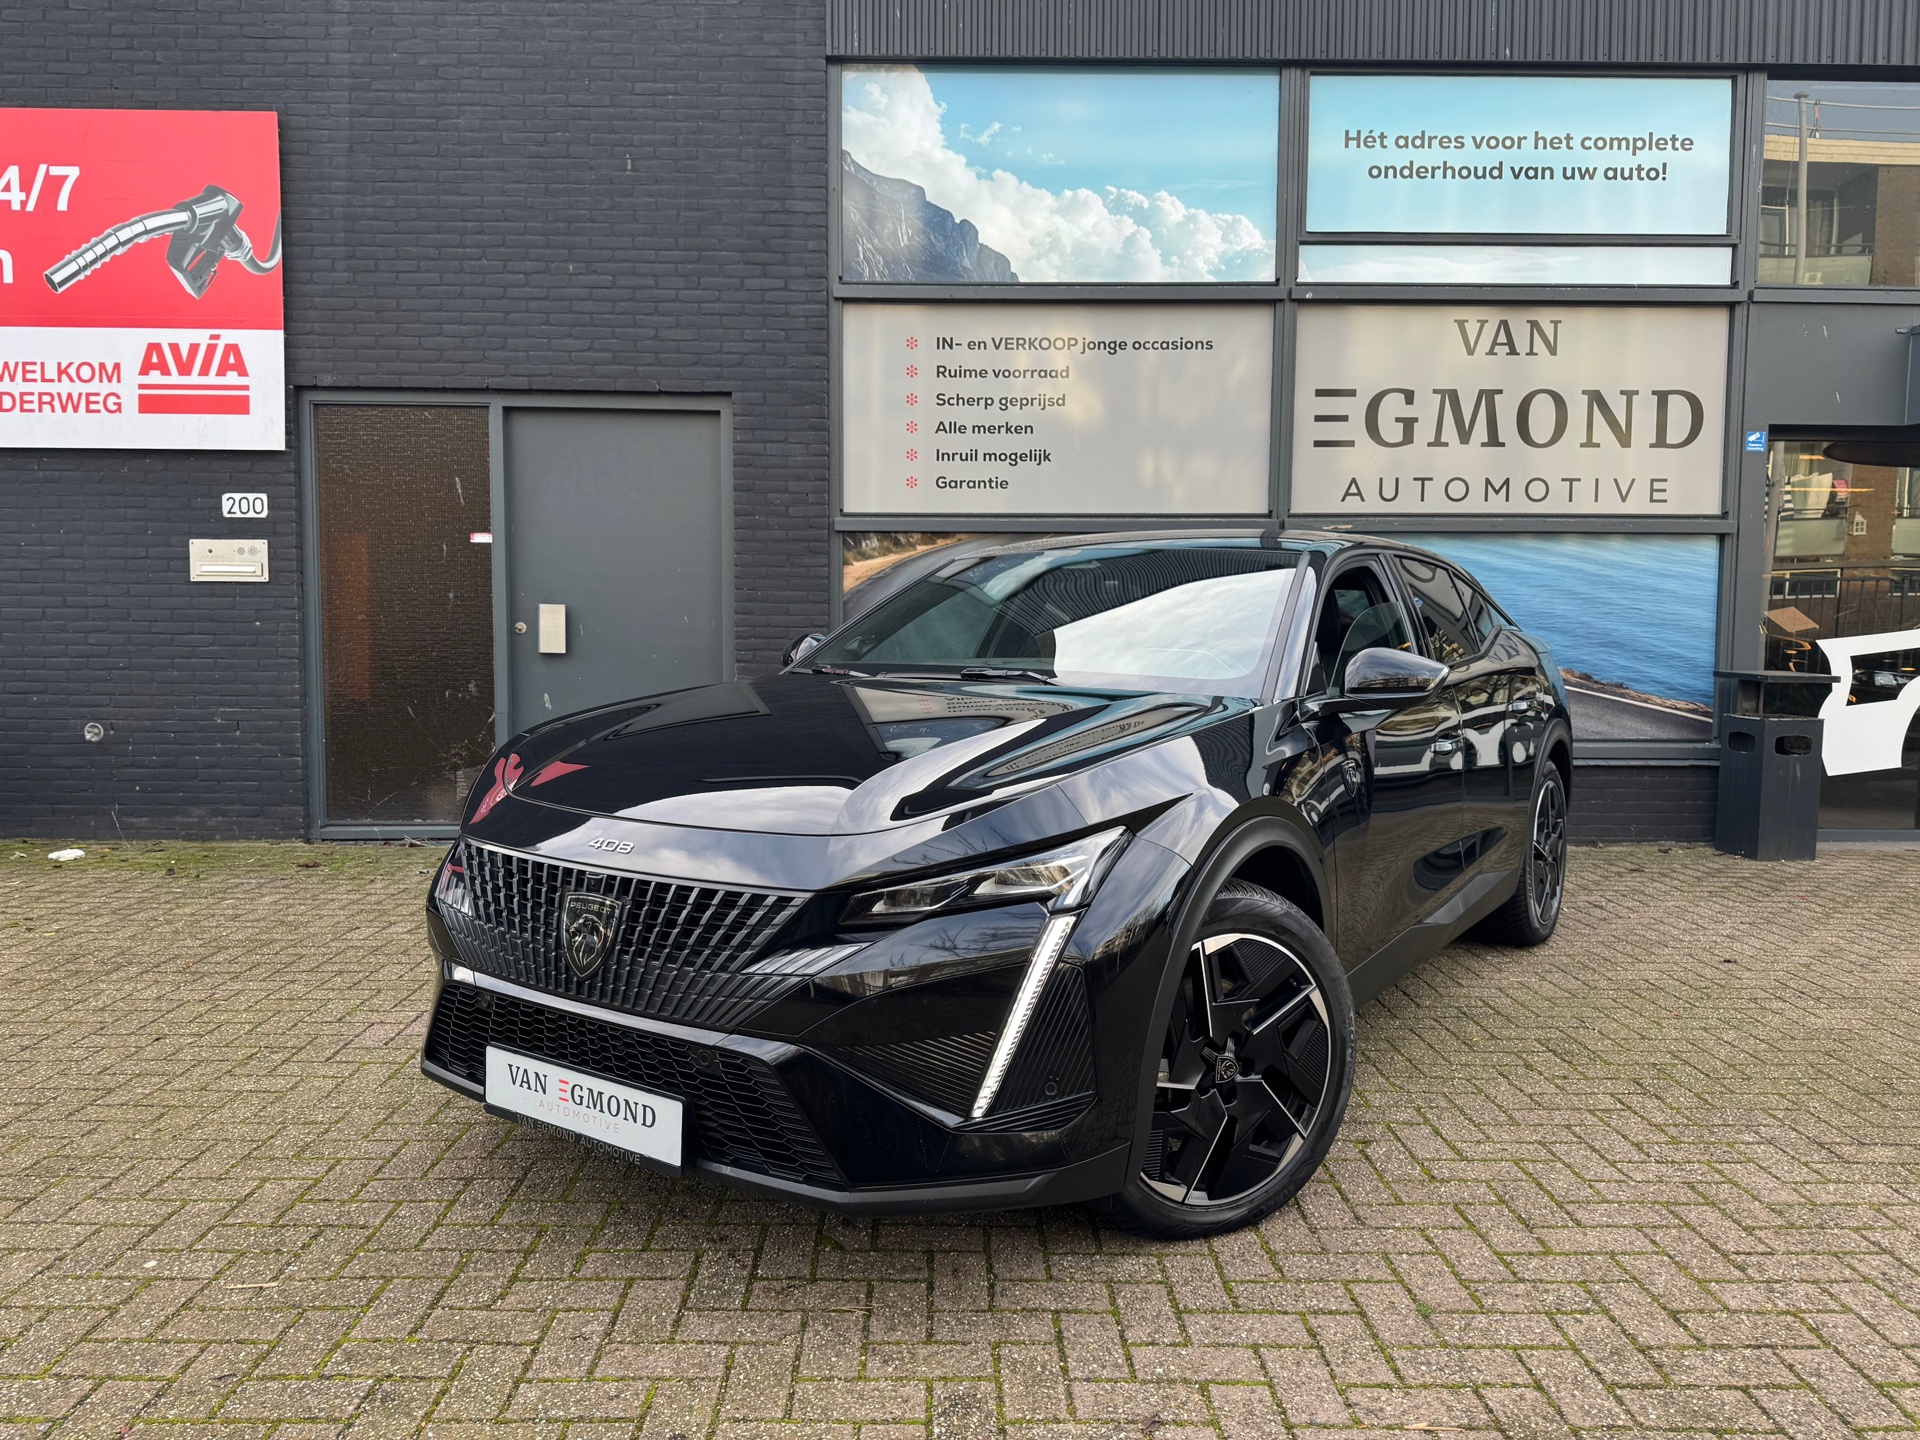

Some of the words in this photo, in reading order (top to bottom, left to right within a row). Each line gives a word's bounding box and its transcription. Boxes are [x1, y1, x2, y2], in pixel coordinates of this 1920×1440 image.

[1344, 129, 1388, 149] Hét
[1394, 130, 1466, 150] adres
[1470, 135, 1528, 150] voor
[1533, 131, 1574, 151] het
[1580, 131, 1694, 157] complete
[1367, 160, 1504, 180] onderhoud
[1509, 166, 1555, 181] van
[1562, 166, 1598, 181] uw
[1603, 161, 1668, 182] auto!
[936, 336, 963, 351] IN-
[967, 340, 987, 351] en
[990, 336, 1079, 351] VERKOOP
[1080, 337, 1128, 356] jonge
[1131, 336, 1214, 352] occasions
[1453, 318, 1563, 357] VAN
[0, 361, 122, 384] WELKOM
[936, 364, 989, 379] Ruime
[991, 364, 1070, 380] voorraad
[935, 392, 995, 411] Scherp
[998, 393, 1066, 411] geprijsd
[934, 420, 968, 435] Alle
[971, 420, 1034, 435] merken
[1312, 387, 1705, 450] EGMOND
[936, 448, 978, 462] Inruil
[982, 448, 1052, 467] mogelijk
[935, 475, 1009, 490] Garantie
[1340, 476, 1669, 504] AUTOMOTIVE
[226, 496, 265, 515] 200
[588, 837, 635, 854] 408
[570, 901, 612, 915] PEUGEOT
[507, 1063, 548, 1096] VAN
[558, 1078, 657, 1128] EGMOND
[538, 1099, 620, 1134] AUTOMOTIVE
[516, 1114, 535, 1129] VAN
[579, 1136, 641, 1166] AUTOMOTIVE
